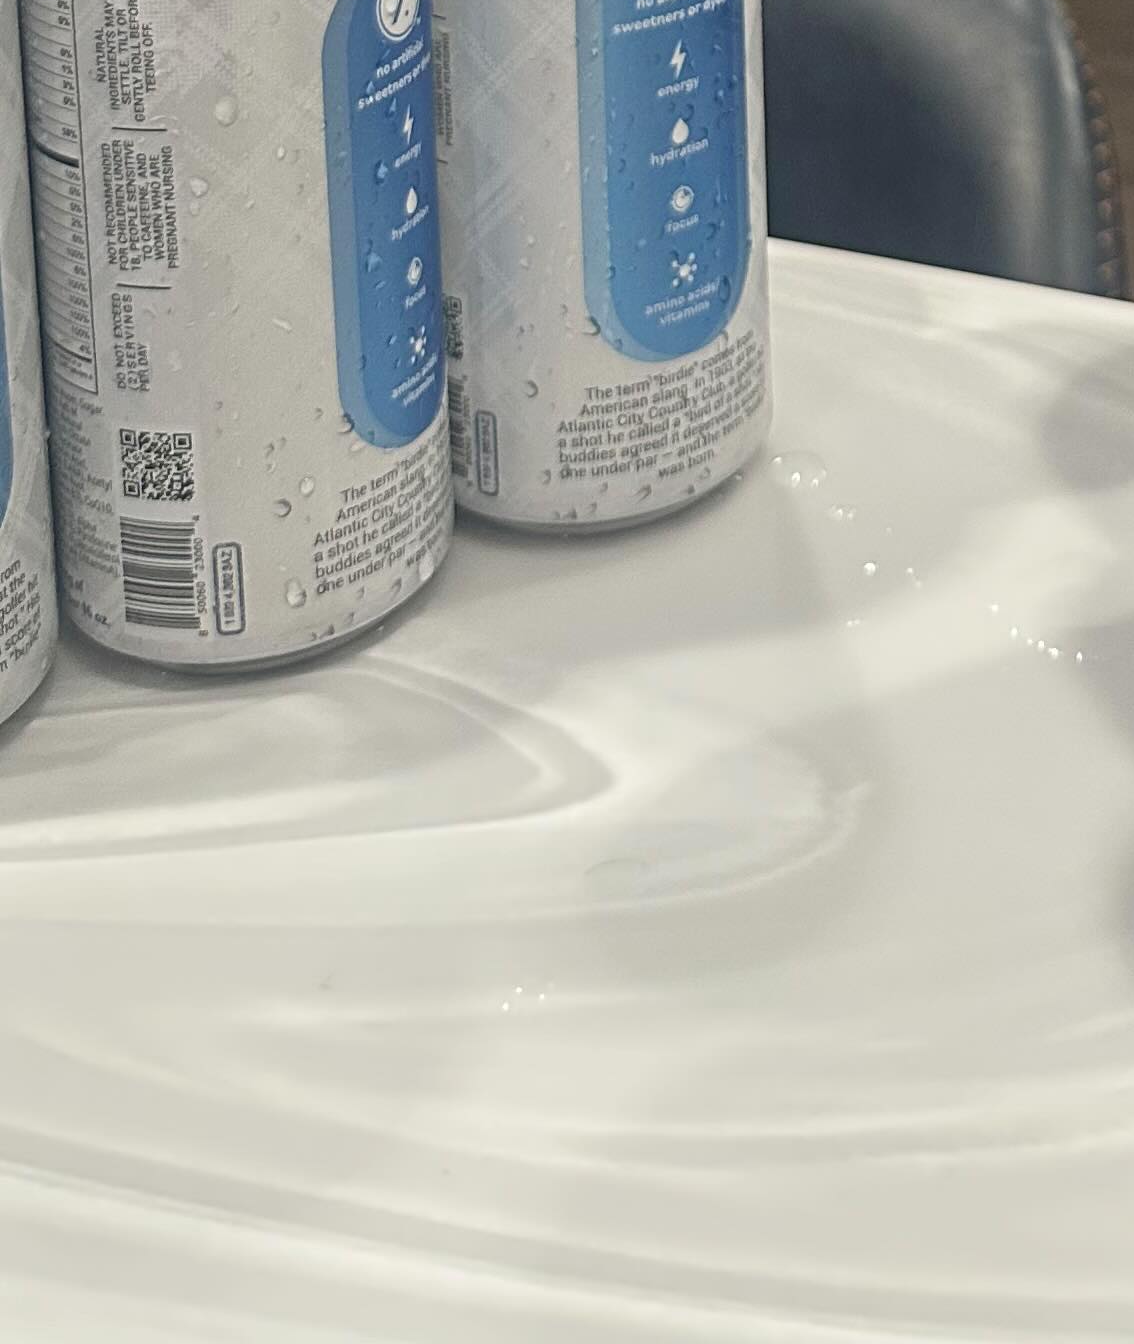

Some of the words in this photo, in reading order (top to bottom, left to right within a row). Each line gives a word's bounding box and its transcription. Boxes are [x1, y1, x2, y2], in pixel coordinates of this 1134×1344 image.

[104, 0, 114, 28] MAY
[116, 8, 127, 26] OR
[687, 3, 702, 16] or
[95, 26, 106, 84] NATURAL
[130, 41, 143, 74] ROLL
[106, 30, 120, 111] INGREDIENTS
[120, 59, 132, 105] SETTLE
[143, 50, 157, 94] TEEING
[132, 76, 146, 123] GENTLY
[657, 76, 701, 97] energy
[112, 139, 124, 182] UNDER
[136, 152, 149, 179] AND
[149, 154, 160, 178] ARE
[650, 139, 710, 166] hydration
[123, 139, 137, 202] SENSITIVE
[161, 144, 176, 201] NURSING
[101, 143, 116, 237] RECOMMENDED
[150, 180, 162, 211] WHO
[115, 183, 129, 244] CHILDREN
[127, 204, 141, 252] PEOPLE
[665, 214, 700, 234] focus
[152, 213, 165, 261] WOMEN
[164, 202, 179, 269] PREGNANT
[107, 240, 118, 265] NOT
[119, 247, 130, 272] FOR
[142, 244, 153, 262] TO
[645, 295, 686, 316] amino
[584, 384, 614, 401] The
[616, 379, 651, 397] term
[579, 395, 649, 418] American
[558, 417, 614, 434] Atlantic
[616, 410, 645, 429] City
[571, 430, 603, 448] shot
[607, 429, 625, 445] he
[628, 418, 671, 442] called
[559, 445, 617, 465] buddies
[621, 435, 669, 459] agreed
[591, 461, 631, 477] under
[635, 453, 659, 473] par
[336, 485, 398, 523] American
[340, 484, 368, 503] The
[313, 517, 369, 547] Atlantic
[327, 536, 360, 560] shot
[362, 529, 379, 545] he
[315, 548, 372, 580] buddies
[348, 557, 387, 584] under
